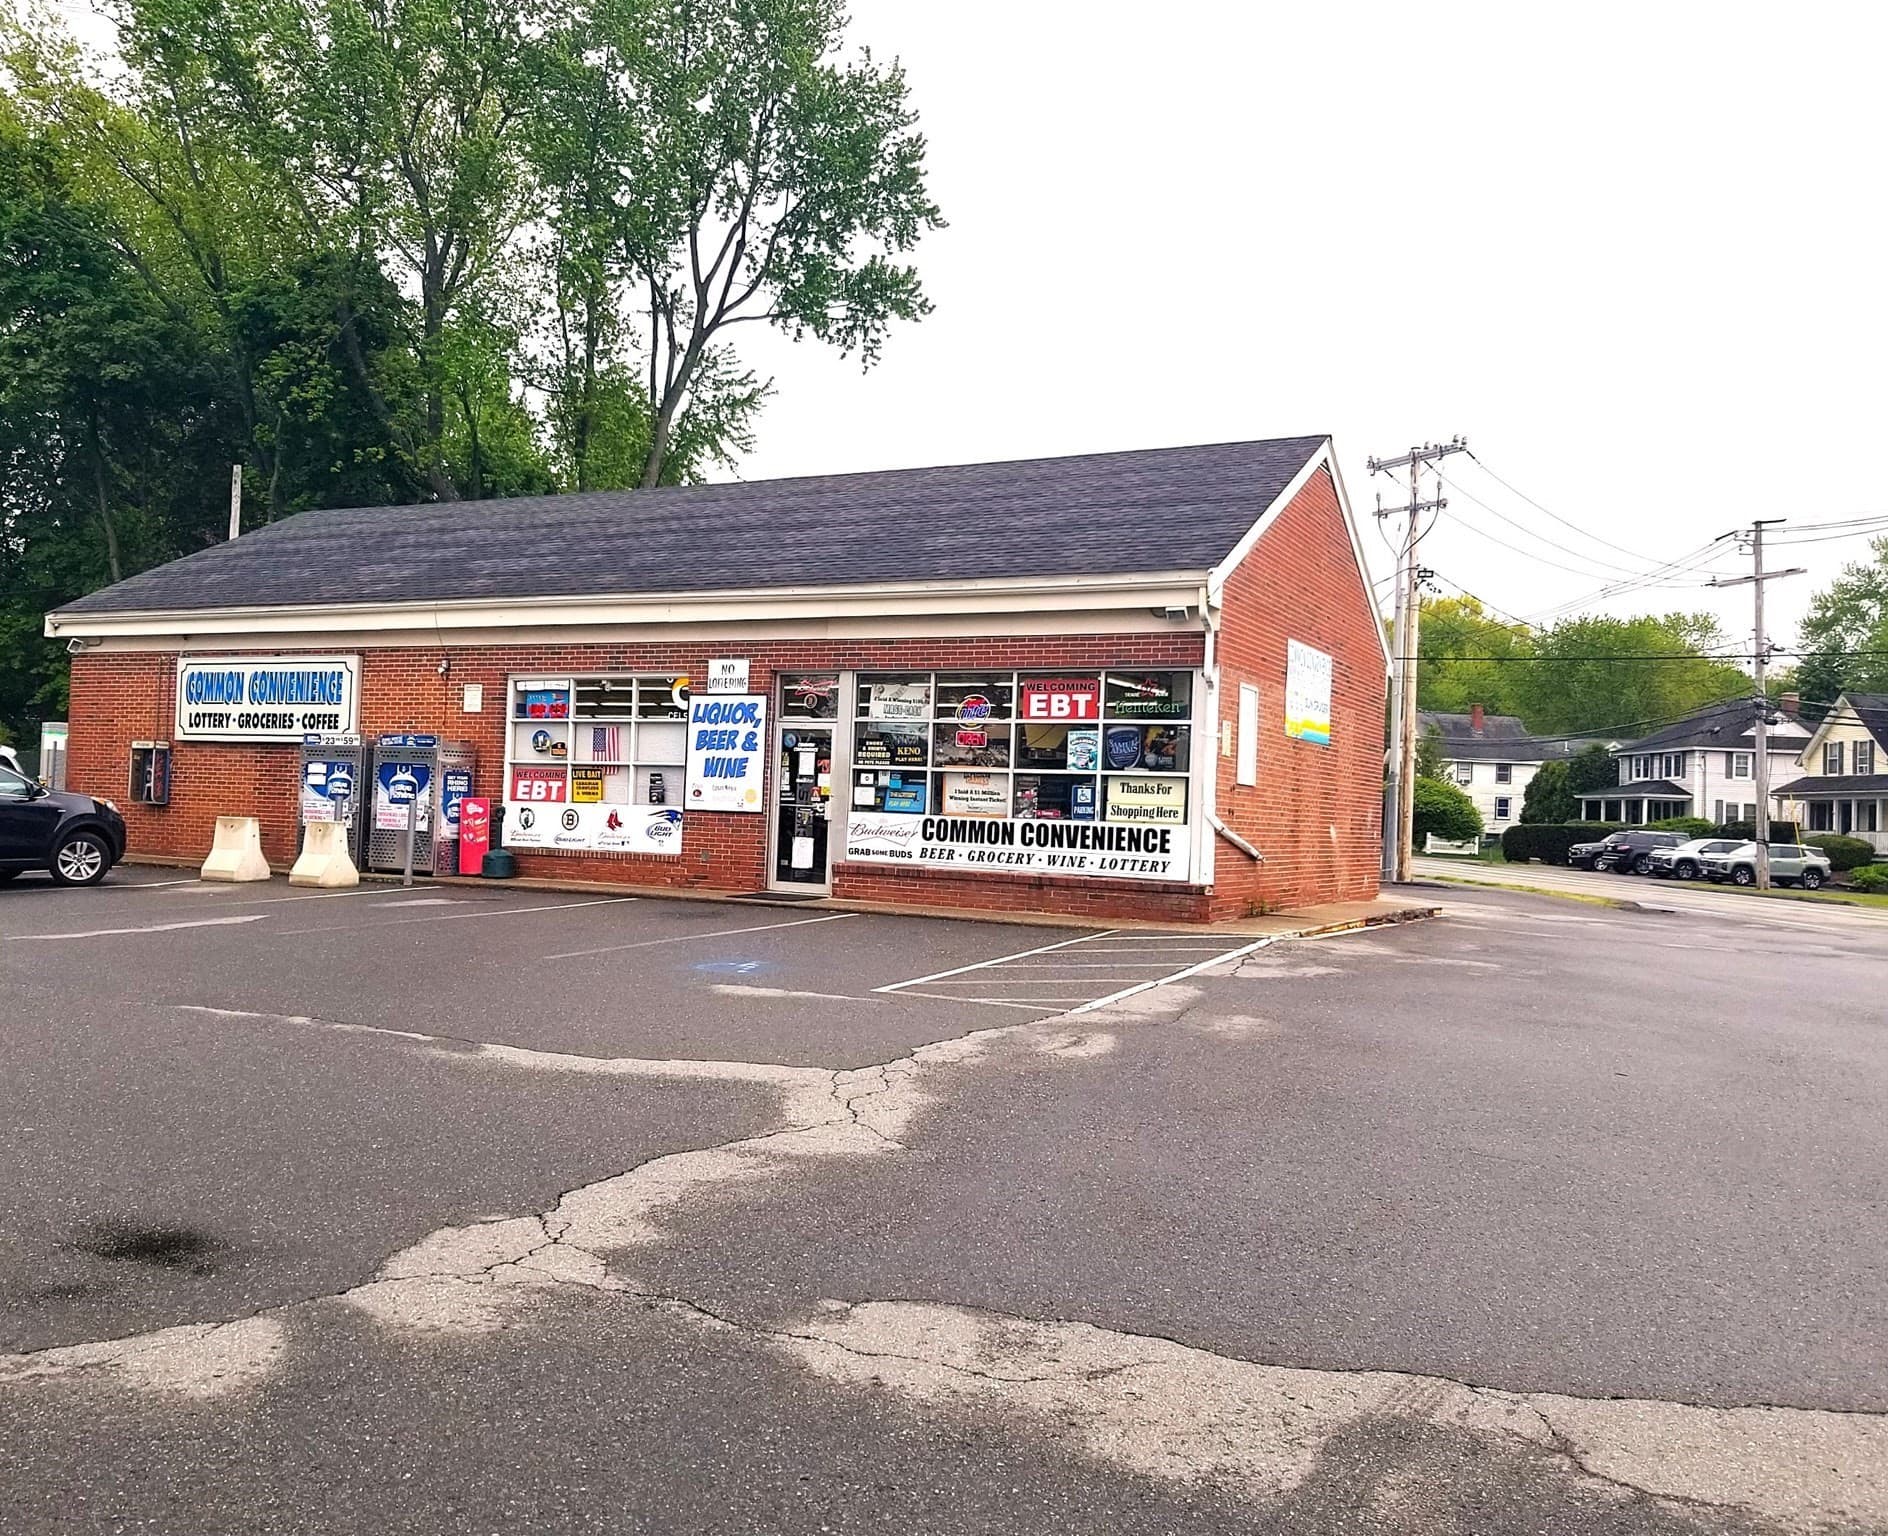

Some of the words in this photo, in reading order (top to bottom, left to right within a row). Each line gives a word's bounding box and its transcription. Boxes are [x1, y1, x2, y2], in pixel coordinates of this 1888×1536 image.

[722, 664, 735, 676] NO
[186, 671, 244, 705] COMMON
[248, 671, 344, 705] CONVENIENCE
[1026, 683, 1096, 692] WELCOMING
[1030, 694, 1092, 717] EBT
[1115, 700, 1180, 714] Heineken
[189, 712, 231, 728] LOTTERY
[238, 713, 294, 729] GROCERIES
[302, 713, 340, 730] COFFEE
[692, 702, 762, 728] LIQUOR,
[696, 730, 739, 751] BEER
[741, 731, 758, 752] &
[958, 733, 984, 746] OPEN
[897, 747, 921, 755] KENO
[516, 771, 566, 779] WELCOMING
[704, 756, 749, 779] WINE
[516, 780, 562, 800] EBT
[1120, 782, 1155, 794] Thanks
[1156, 783, 1173, 795] For
[1110, 805, 1155, 819] Shopping
[1156, 807, 1179, 818] Here
[849, 822, 918, 838] Budweiser
[922, 818, 1014, 845] COMMON
[1021, 822, 1170, 853] CONVENIENCE
[848, 847, 870, 856] GRAB
[889, 850, 912, 859] BUDS
[920, 848, 956, 860] BEER
[967, 850, 1035, 865] GROCERY
[1047, 855, 1087, 868] WINE
[1100, 858, 1171, 873] LOTTERY
